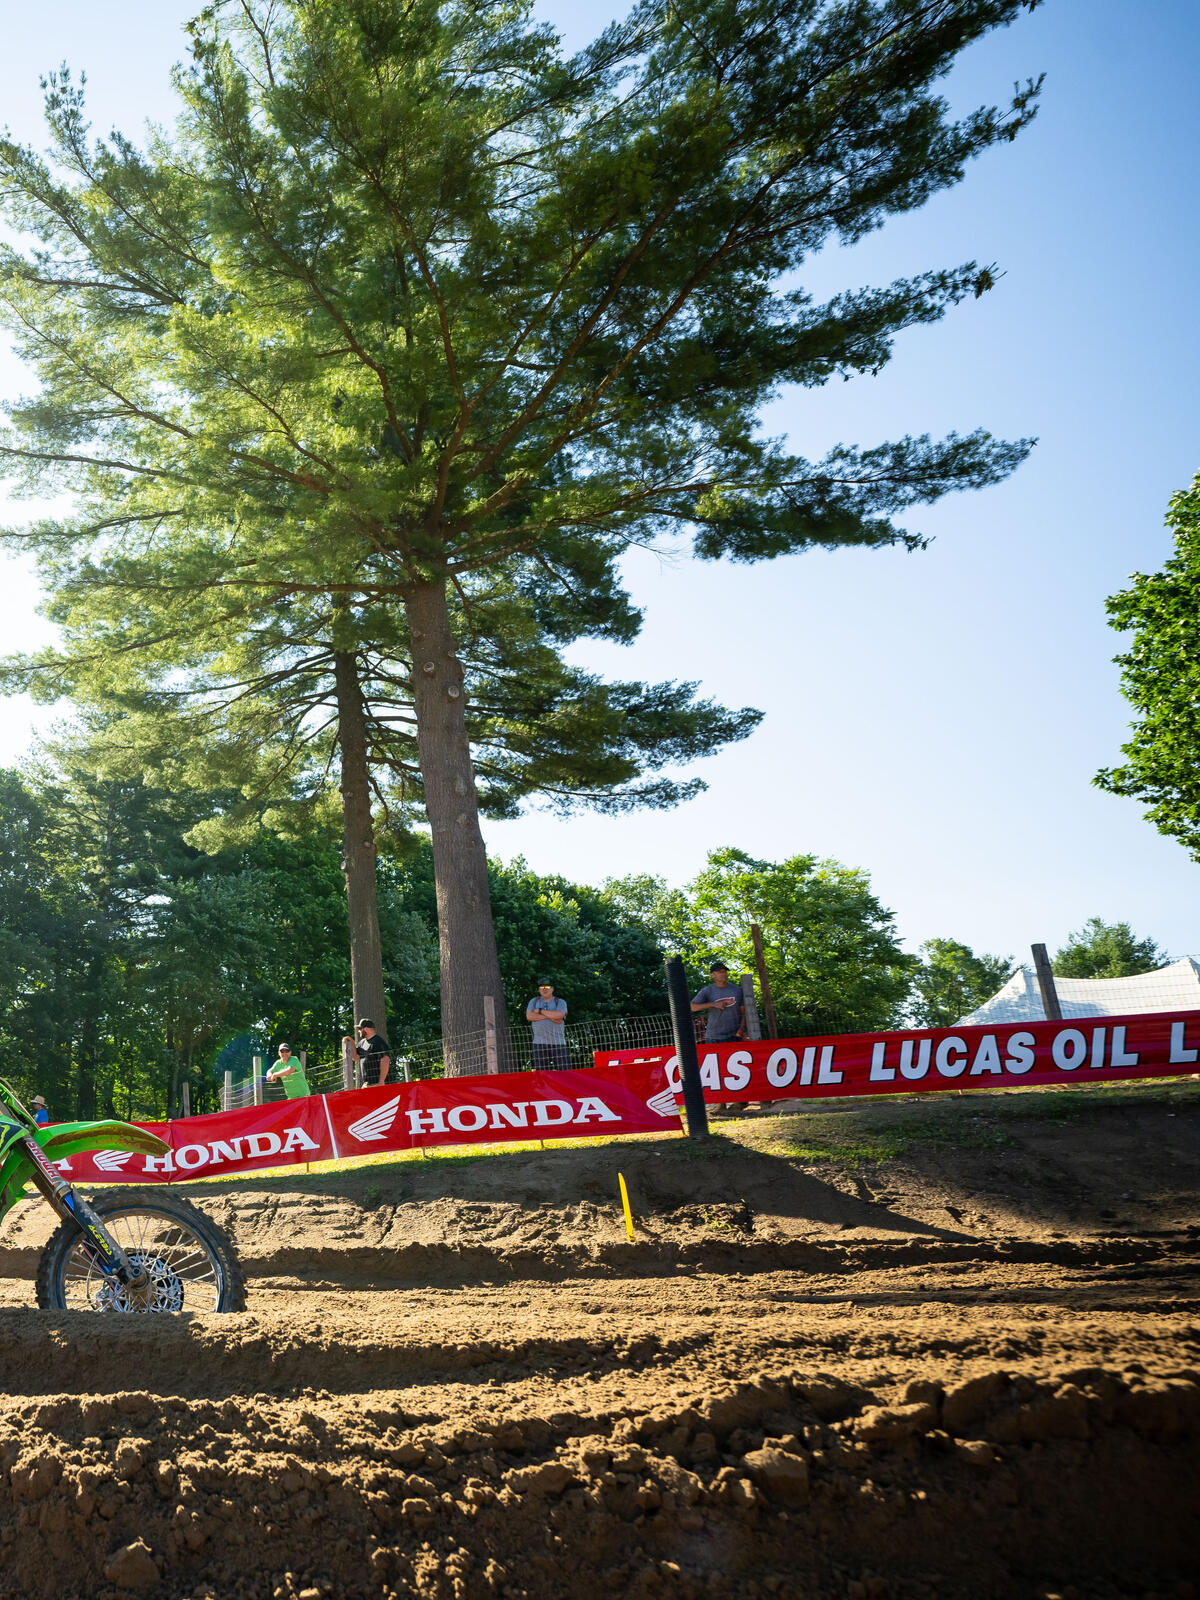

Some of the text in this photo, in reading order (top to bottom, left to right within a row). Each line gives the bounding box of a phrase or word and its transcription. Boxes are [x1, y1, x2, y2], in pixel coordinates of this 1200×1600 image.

[608, 1050, 753, 1094] CAS
[766, 1045, 843, 1088] OIL
[869, 1031, 1036, 1081] LUCAS
[1052, 1025, 1139, 1071] OIL
[405, 1096, 622, 1135] HONDA
[27, 1141, 60, 1178] SHOWA
[142, 1127, 320, 1172] HONDA
